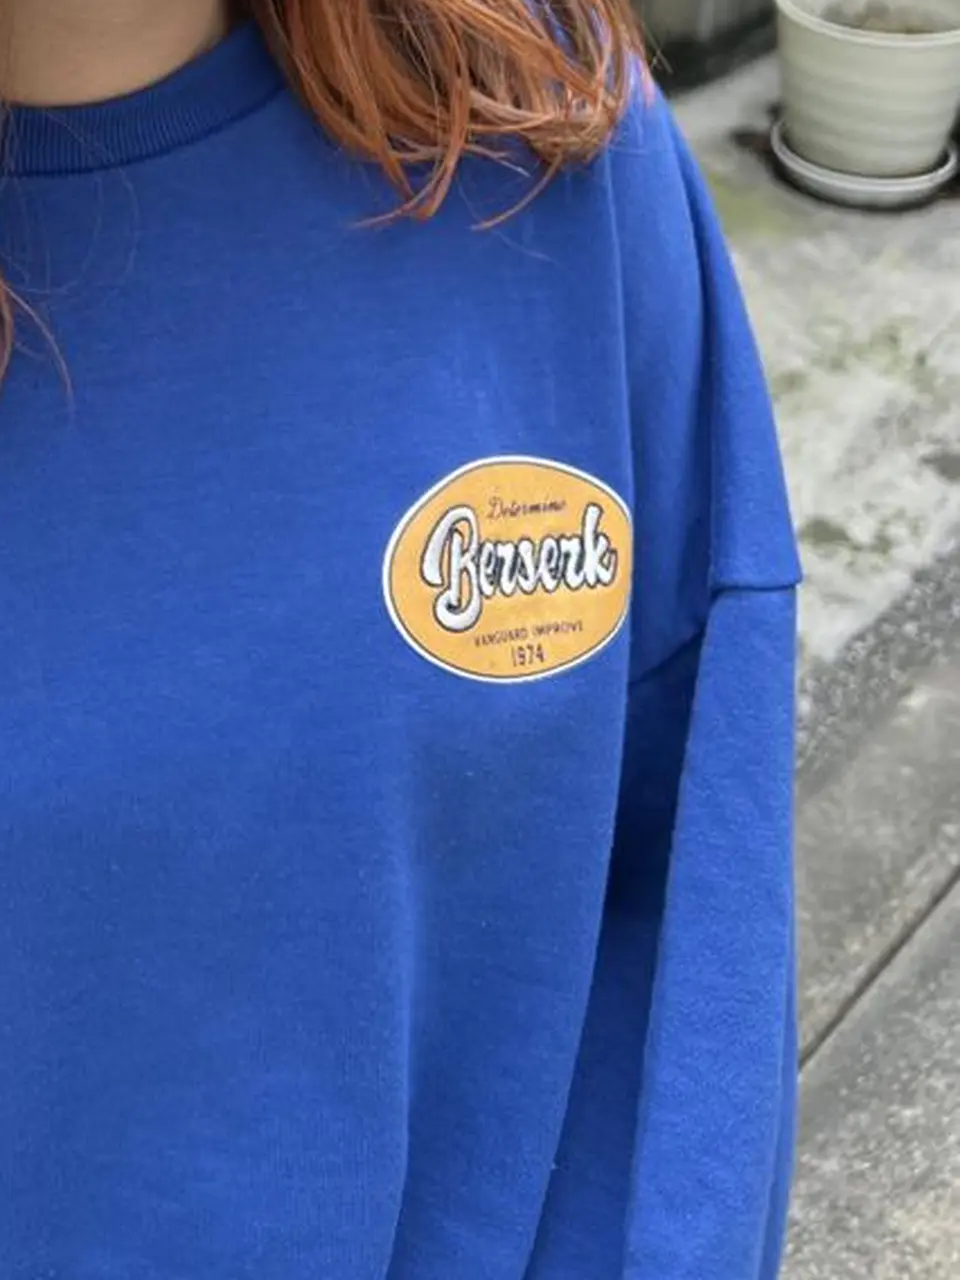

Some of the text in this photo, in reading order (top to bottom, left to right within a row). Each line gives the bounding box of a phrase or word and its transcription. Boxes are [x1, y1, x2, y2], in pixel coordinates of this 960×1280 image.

[420, 503, 617, 634] Berserk
[473, 620, 583, 648] VANGUARD IMPROVE
[510, 643, 545, 667] 1974
